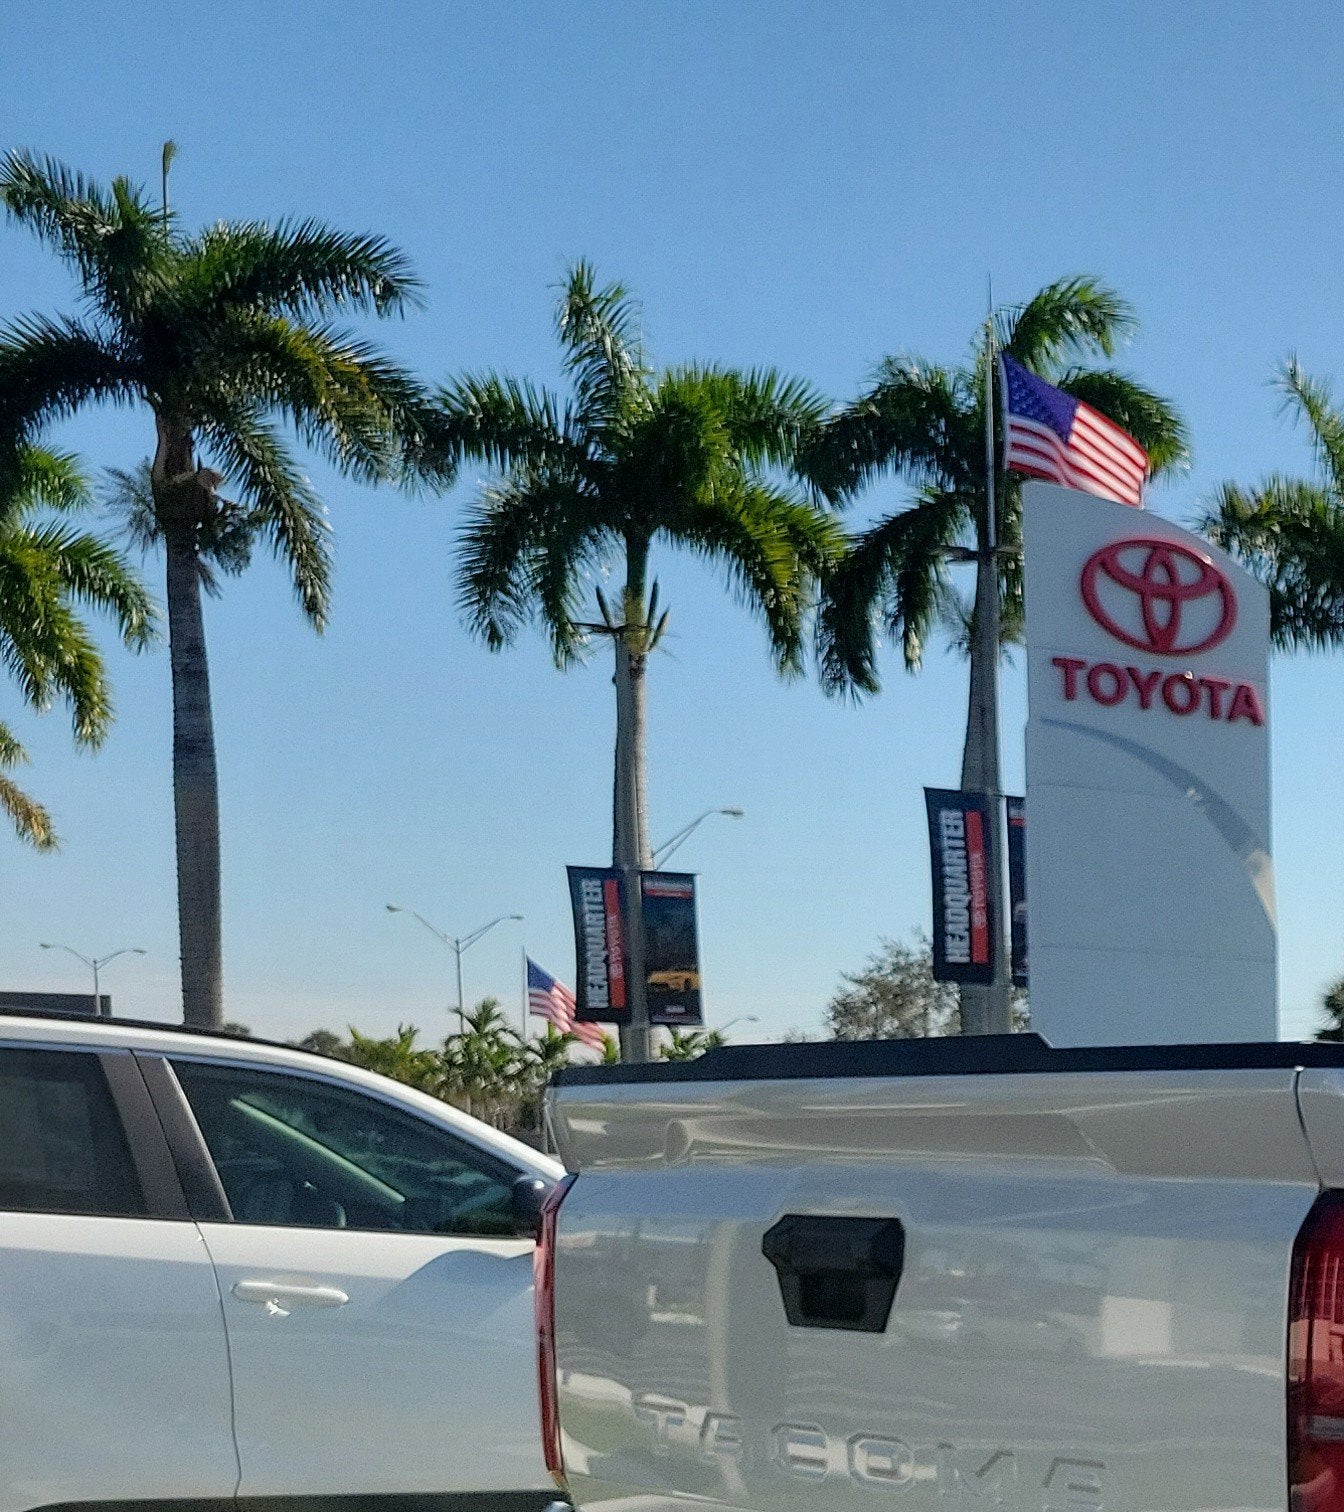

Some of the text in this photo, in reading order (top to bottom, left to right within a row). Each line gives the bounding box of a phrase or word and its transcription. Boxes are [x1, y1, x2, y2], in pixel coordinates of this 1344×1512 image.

[1052, 657, 1264, 726] TOYOTA
[581, 878, 609, 1009] HEADQUARTER
[939, 809, 970, 963] HEADQUARTER
